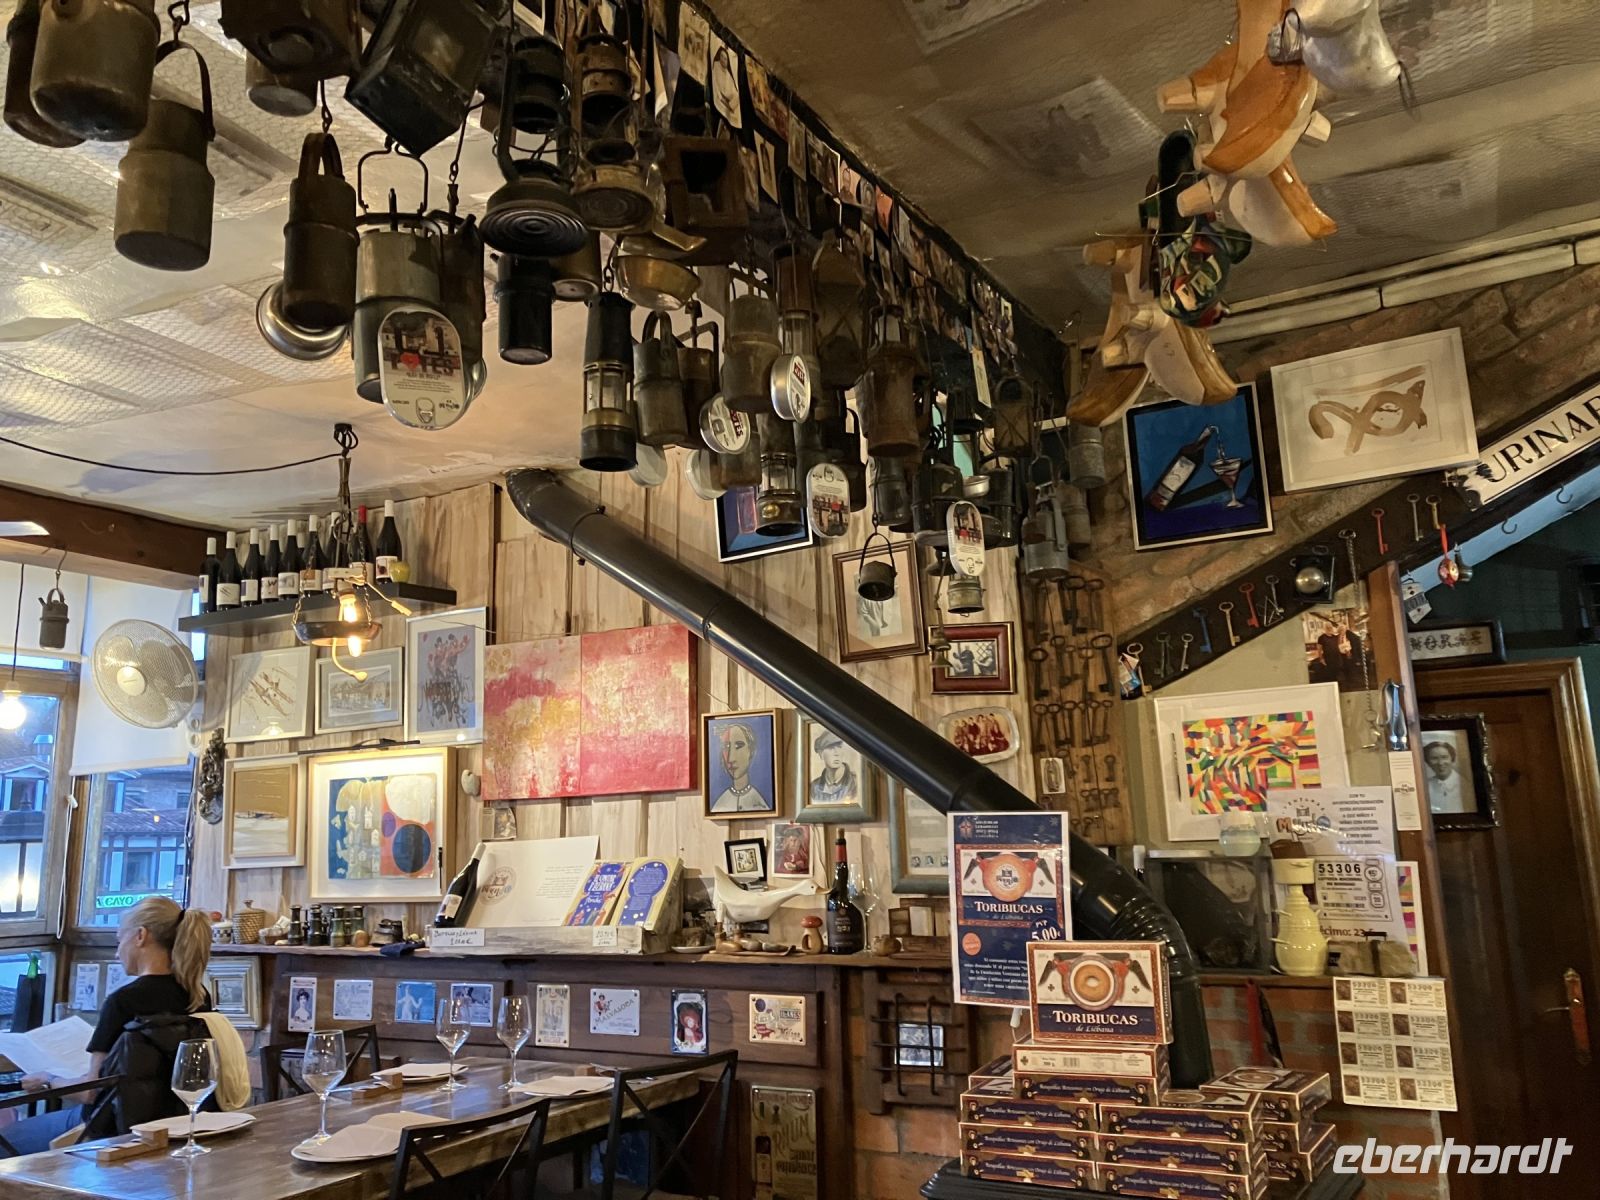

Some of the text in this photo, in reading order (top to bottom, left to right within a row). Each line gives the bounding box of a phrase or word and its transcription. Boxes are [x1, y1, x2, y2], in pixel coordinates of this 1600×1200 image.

[1318, 863, 1361, 874] 53306
[105, 896, 134, 906] CAYO
[974, 901, 1044, 914] TORIBIUCAS
[1052, 1010, 1139, 1026] TORIBIUCAS
[1075, 1024, 1084, 1032] de
